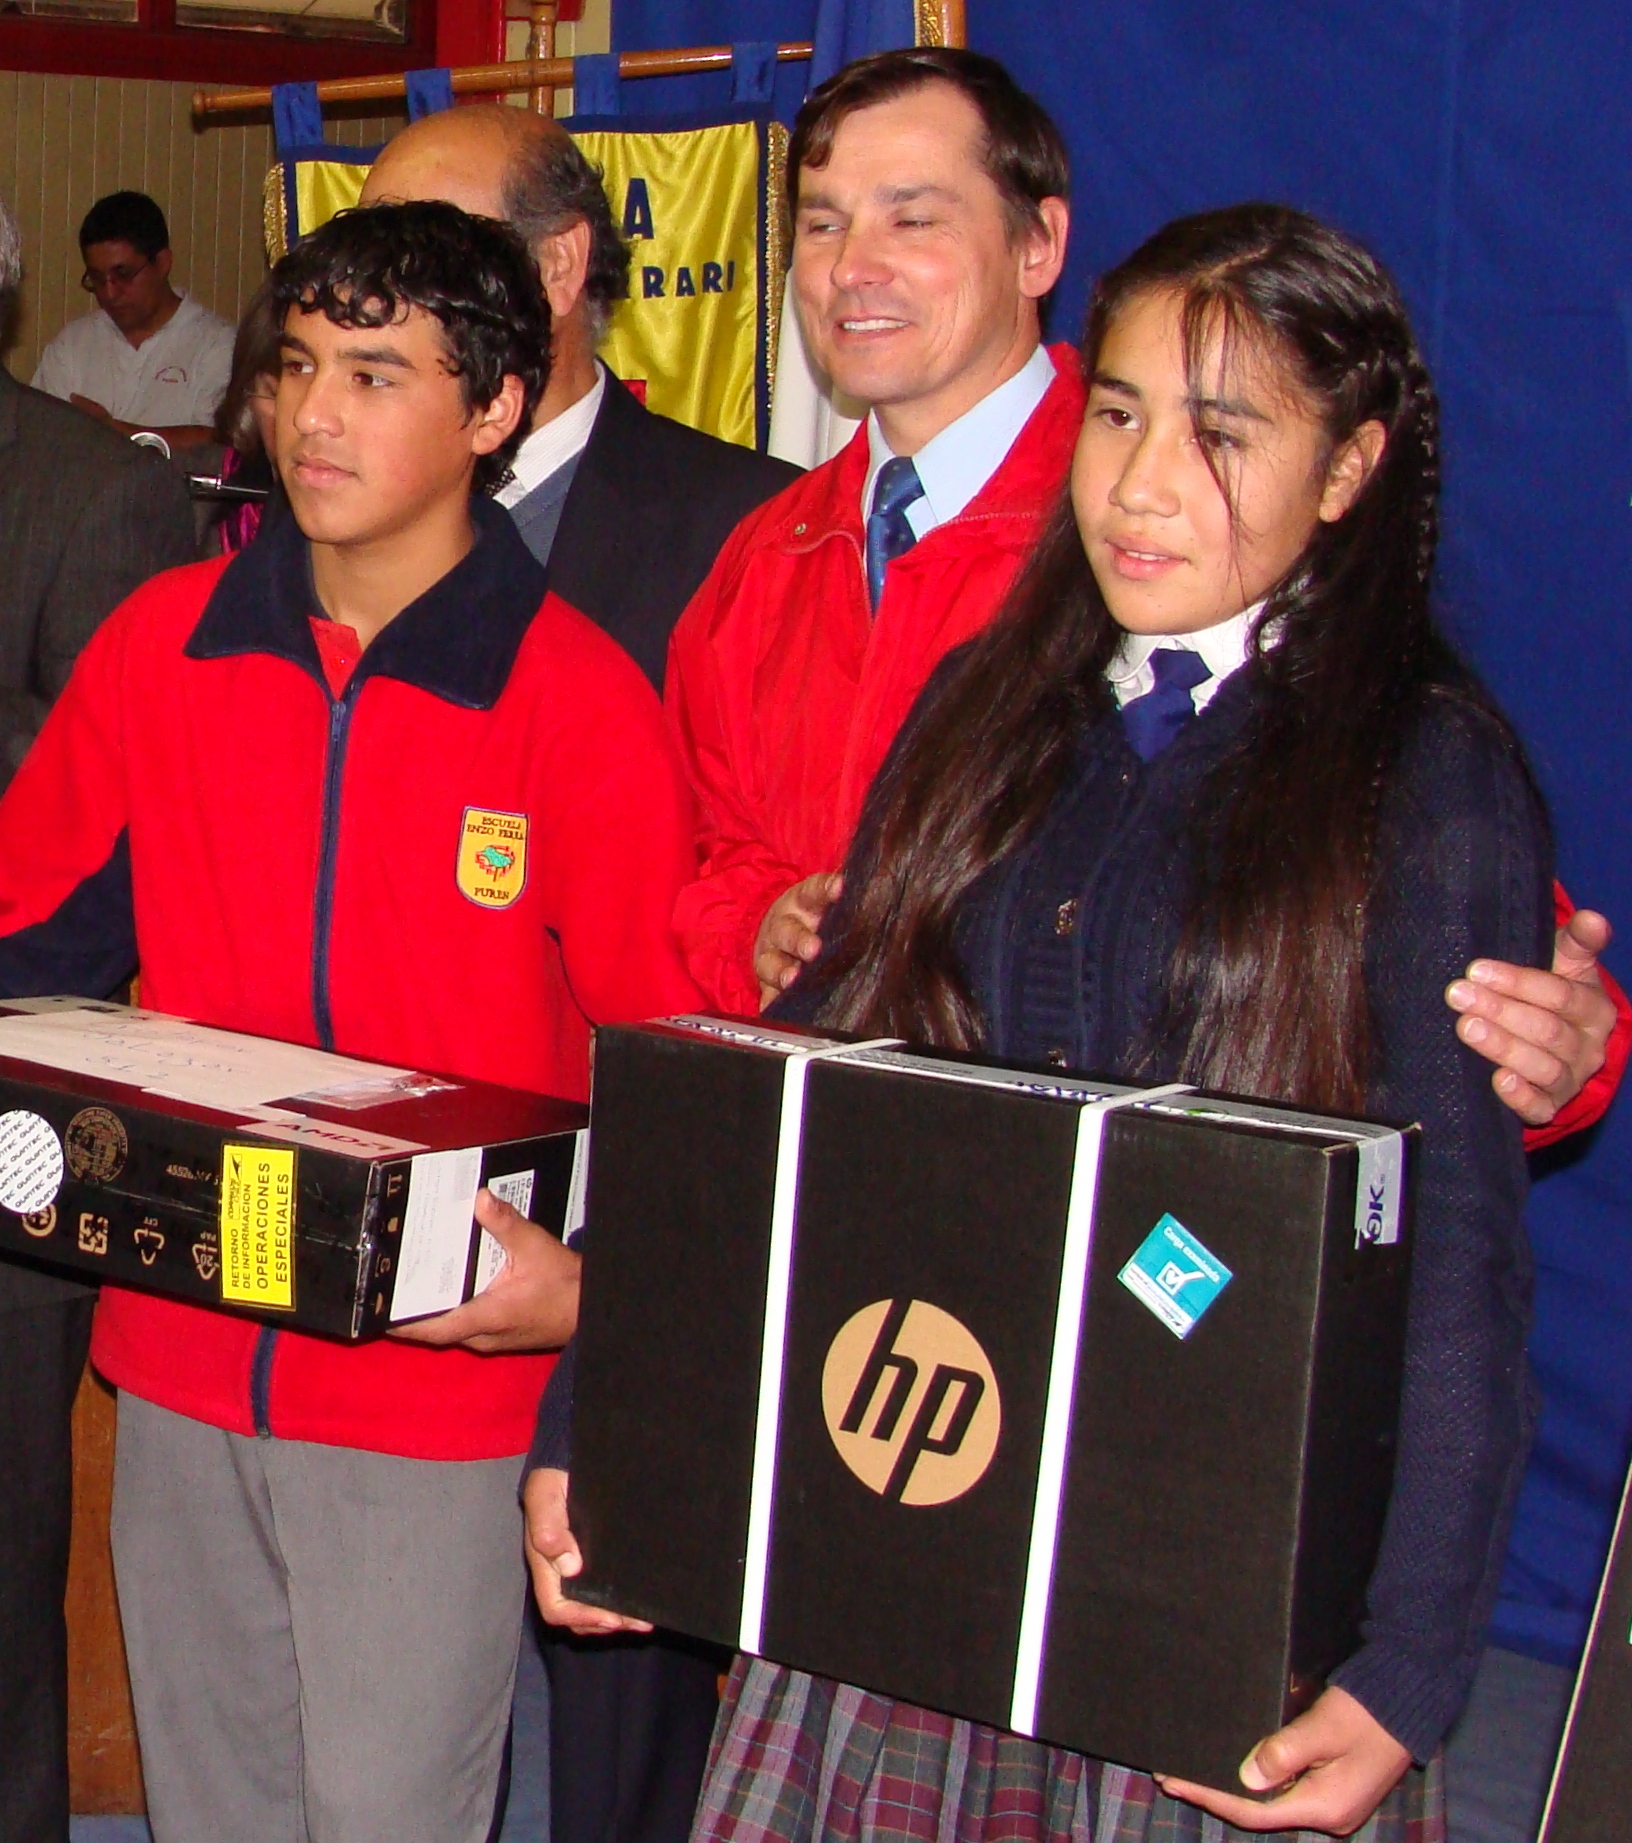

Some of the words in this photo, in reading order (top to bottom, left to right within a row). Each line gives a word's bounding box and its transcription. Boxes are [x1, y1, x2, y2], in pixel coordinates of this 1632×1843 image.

[641, 260, 736, 299] RARI
[231, 1228, 240, 1288] RETORNO
[242, 1183, 251, 1270] INFORMACION
[256, 1162, 270, 1289] OPERACIONES
[275, 1173, 289, 1283] ESPECIALES
[242, 1272, 251, 1289] DE
[839, 1300, 985, 1504] hp
